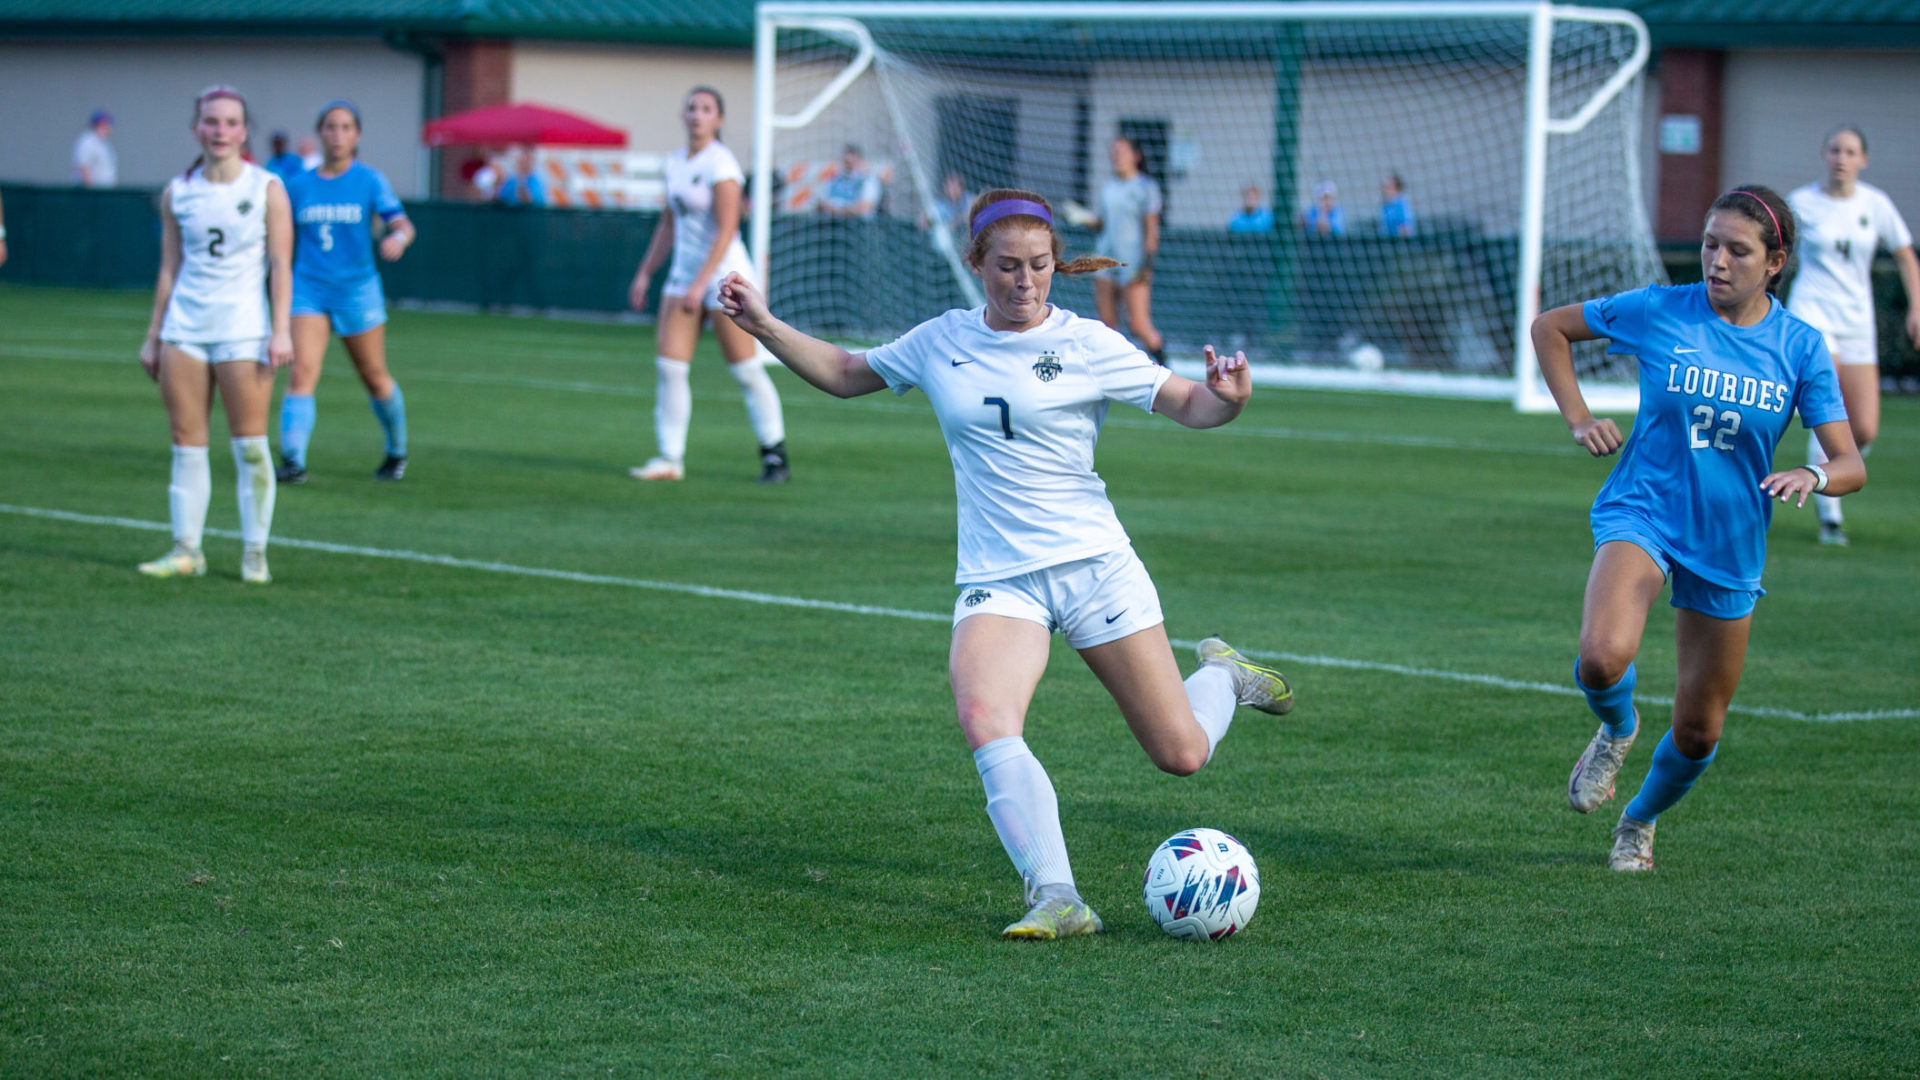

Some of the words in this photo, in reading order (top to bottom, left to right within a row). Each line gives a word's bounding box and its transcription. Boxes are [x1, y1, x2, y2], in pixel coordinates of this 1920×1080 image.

[207, 227, 224, 257] 2
[319, 224, 334, 252] 5
[1666, 363, 1789, 413] LOURDES
[983, 396, 1015, 441] 7
[1690, 404, 1742, 451] 22
